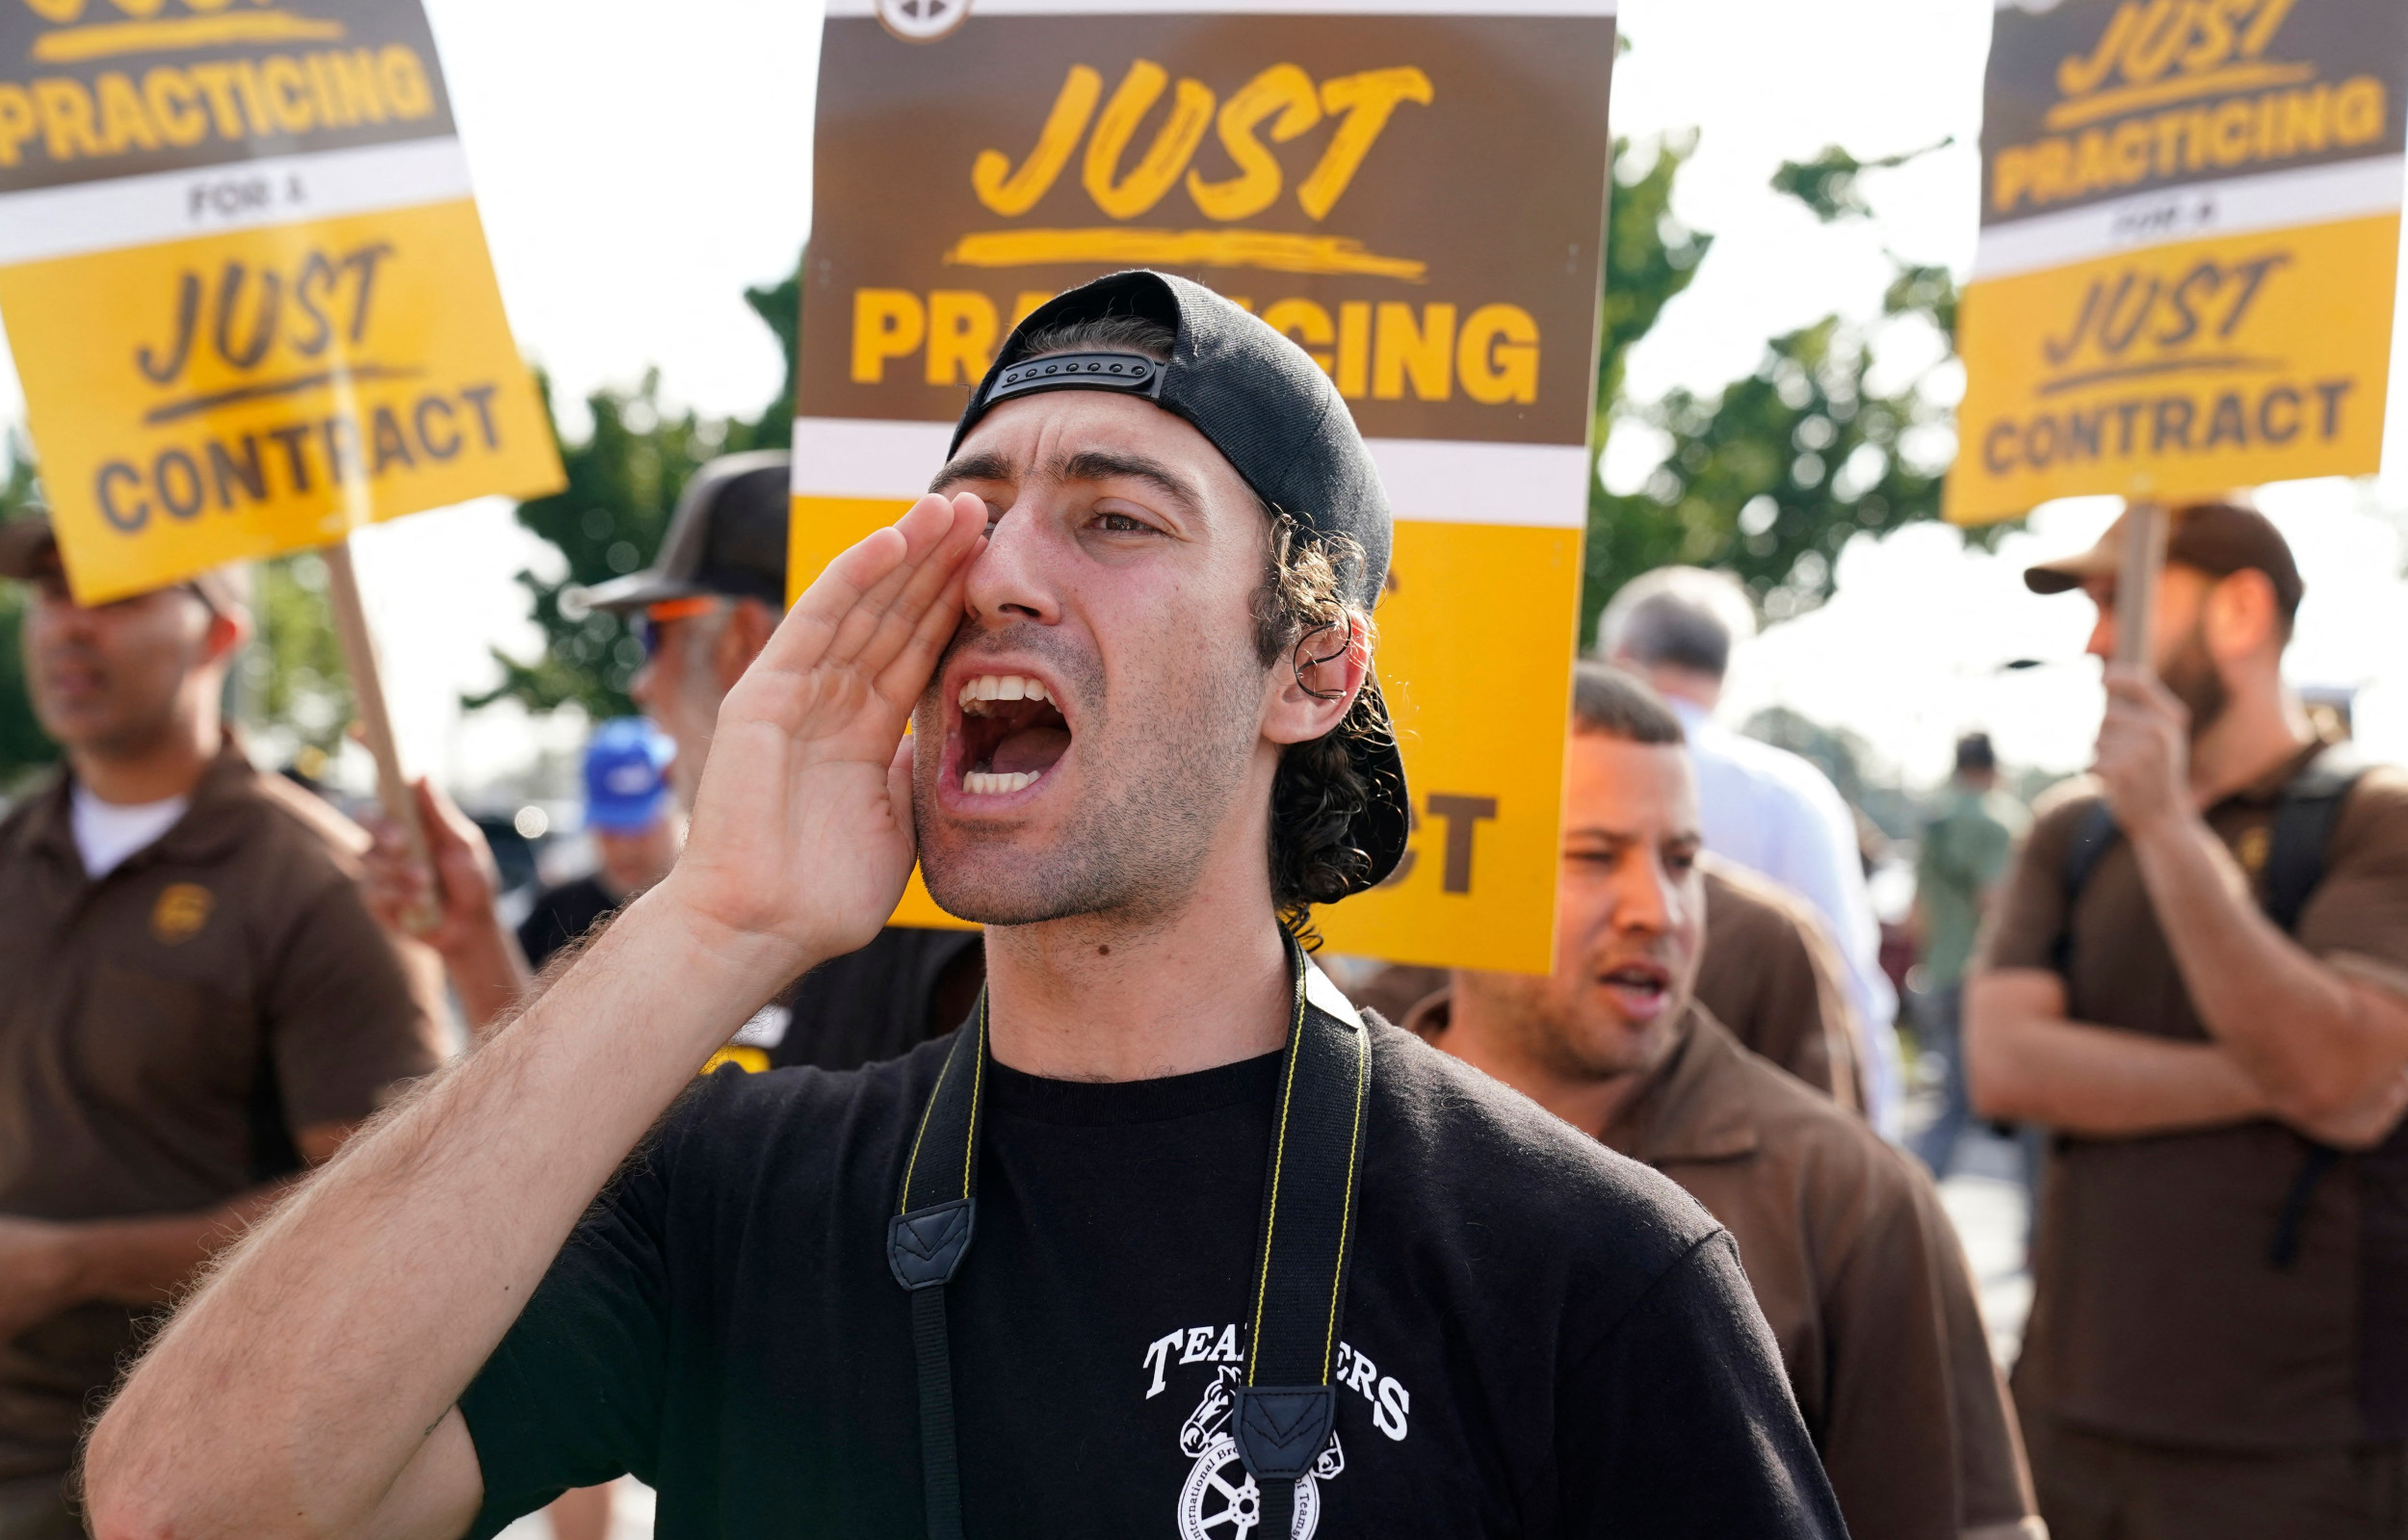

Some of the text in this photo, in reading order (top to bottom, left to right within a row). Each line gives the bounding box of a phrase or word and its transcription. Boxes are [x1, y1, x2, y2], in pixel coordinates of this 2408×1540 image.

[0, 42, 435, 167] PRACTICING
[972, 58, 1433, 222] JUST
[1993, 75, 2388, 211] PRACTICING
[136, 241, 395, 385] JUST
[2042, 250, 2296, 366] JUST
[93, 382, 503, 535] CONTRACT
[1981, 378, 2354, 476] CONTRACT
